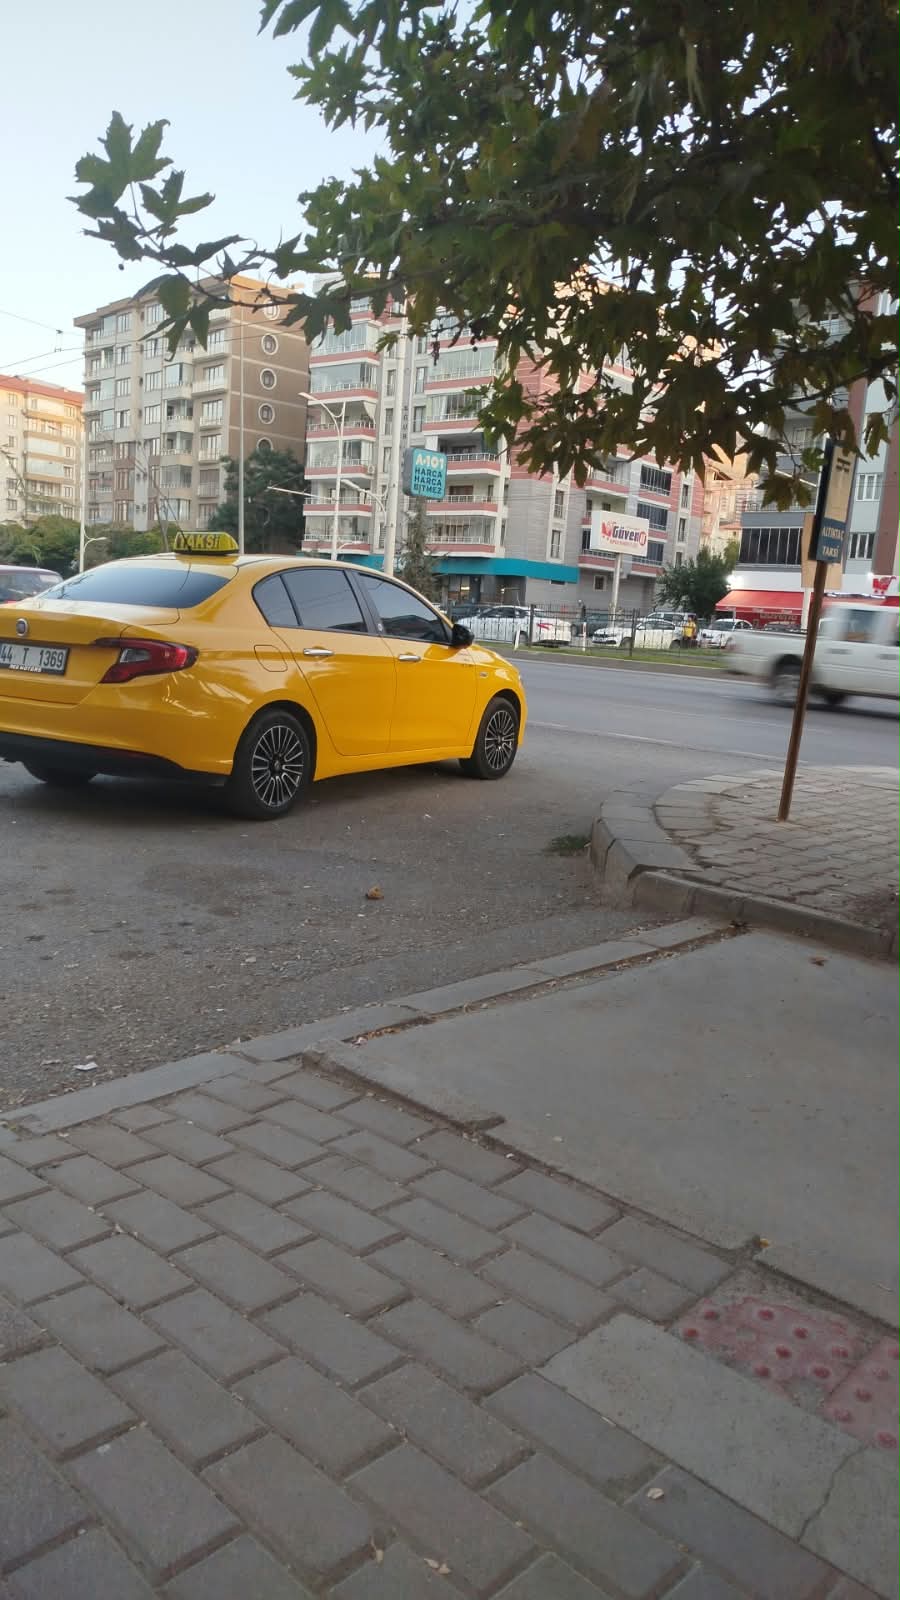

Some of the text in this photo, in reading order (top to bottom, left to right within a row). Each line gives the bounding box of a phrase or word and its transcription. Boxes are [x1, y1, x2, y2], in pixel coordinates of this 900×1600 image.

[415, 466, 443, 478] HARCA
[415, 475, 442, 487] HARCA
[612, 525, 640, 543] Güven
[822, 545, 840, 557] TAKSİ
[0, 645, 64, 668] 44 T 1369
